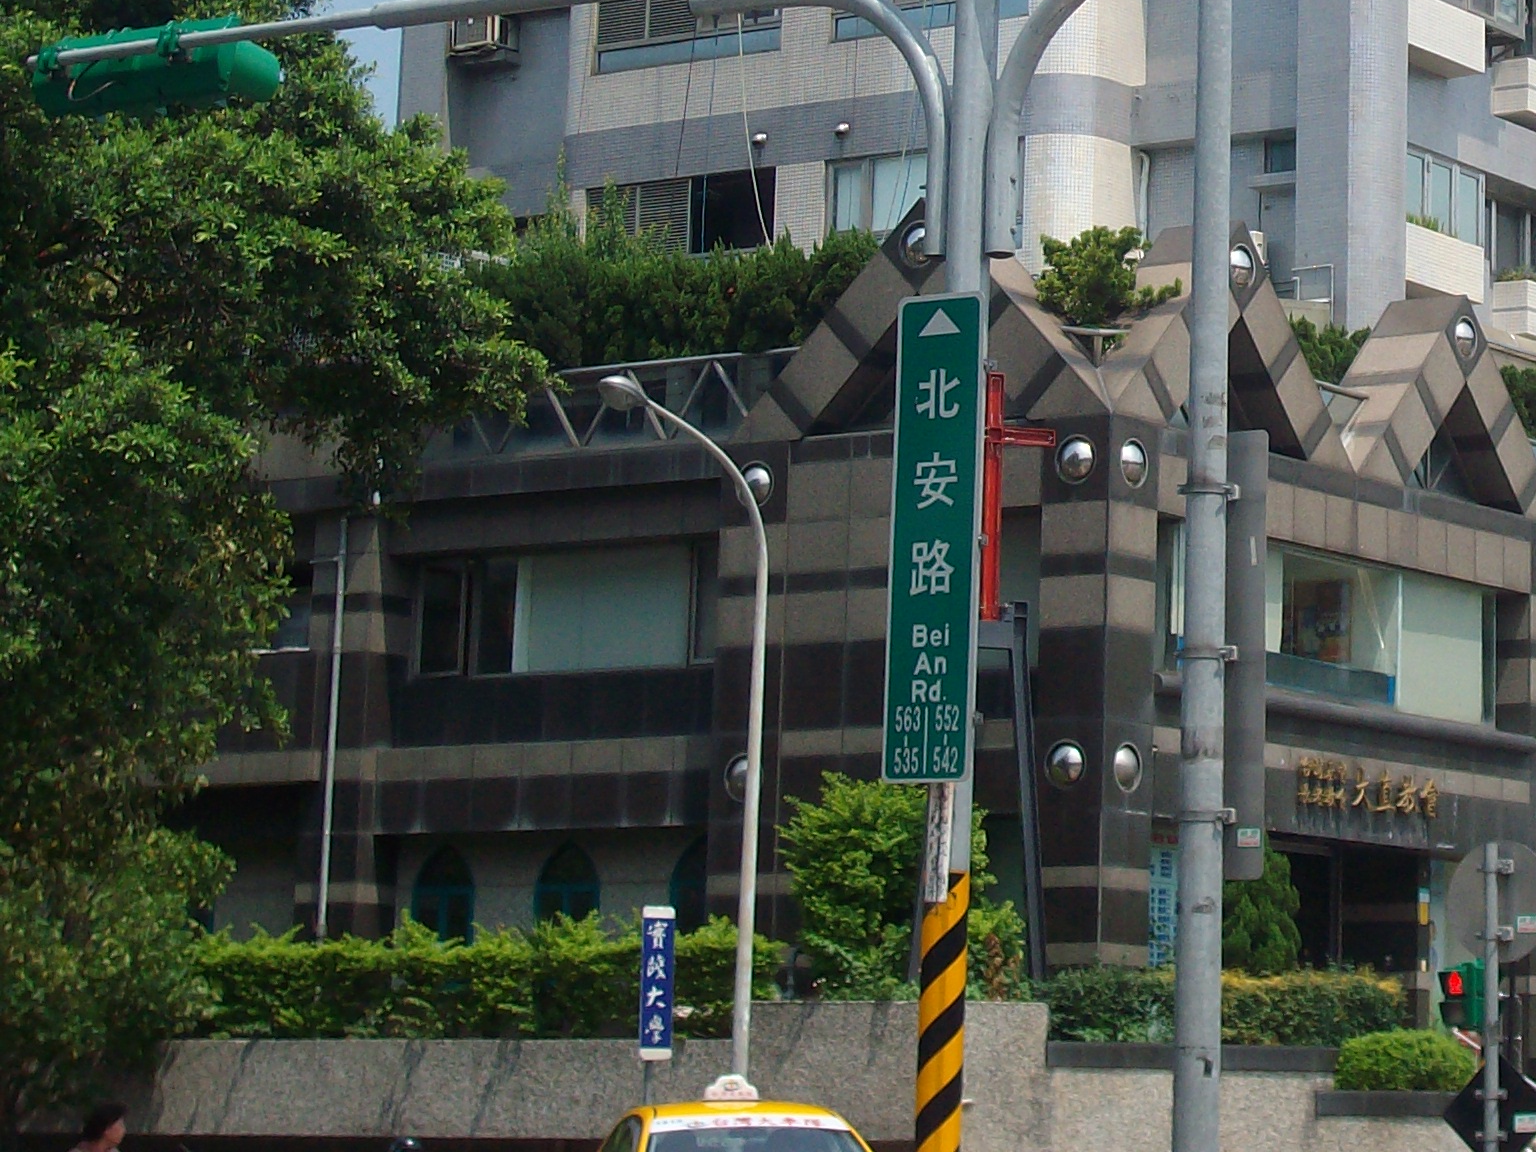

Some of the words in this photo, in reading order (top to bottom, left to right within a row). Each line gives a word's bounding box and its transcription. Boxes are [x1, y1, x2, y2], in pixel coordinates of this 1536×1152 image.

[909, 367, 961, 596] 北安路
[911, 623, 950, 649] Bei
[913, 651, 948, 676] An
[911, 678, 947, 704] Rd.
[895, 706, 921, 733] 563
[934, 704, 960, 732] 552
[893, 747, 919, 774] 535
[932, 746, 959, 773] 542
[1351, 766, 1439, 820] 大直教會
[644, 919, 669, 1045] 實踐大學
[712, 1116, 823, 1128] 台灣大車隊
